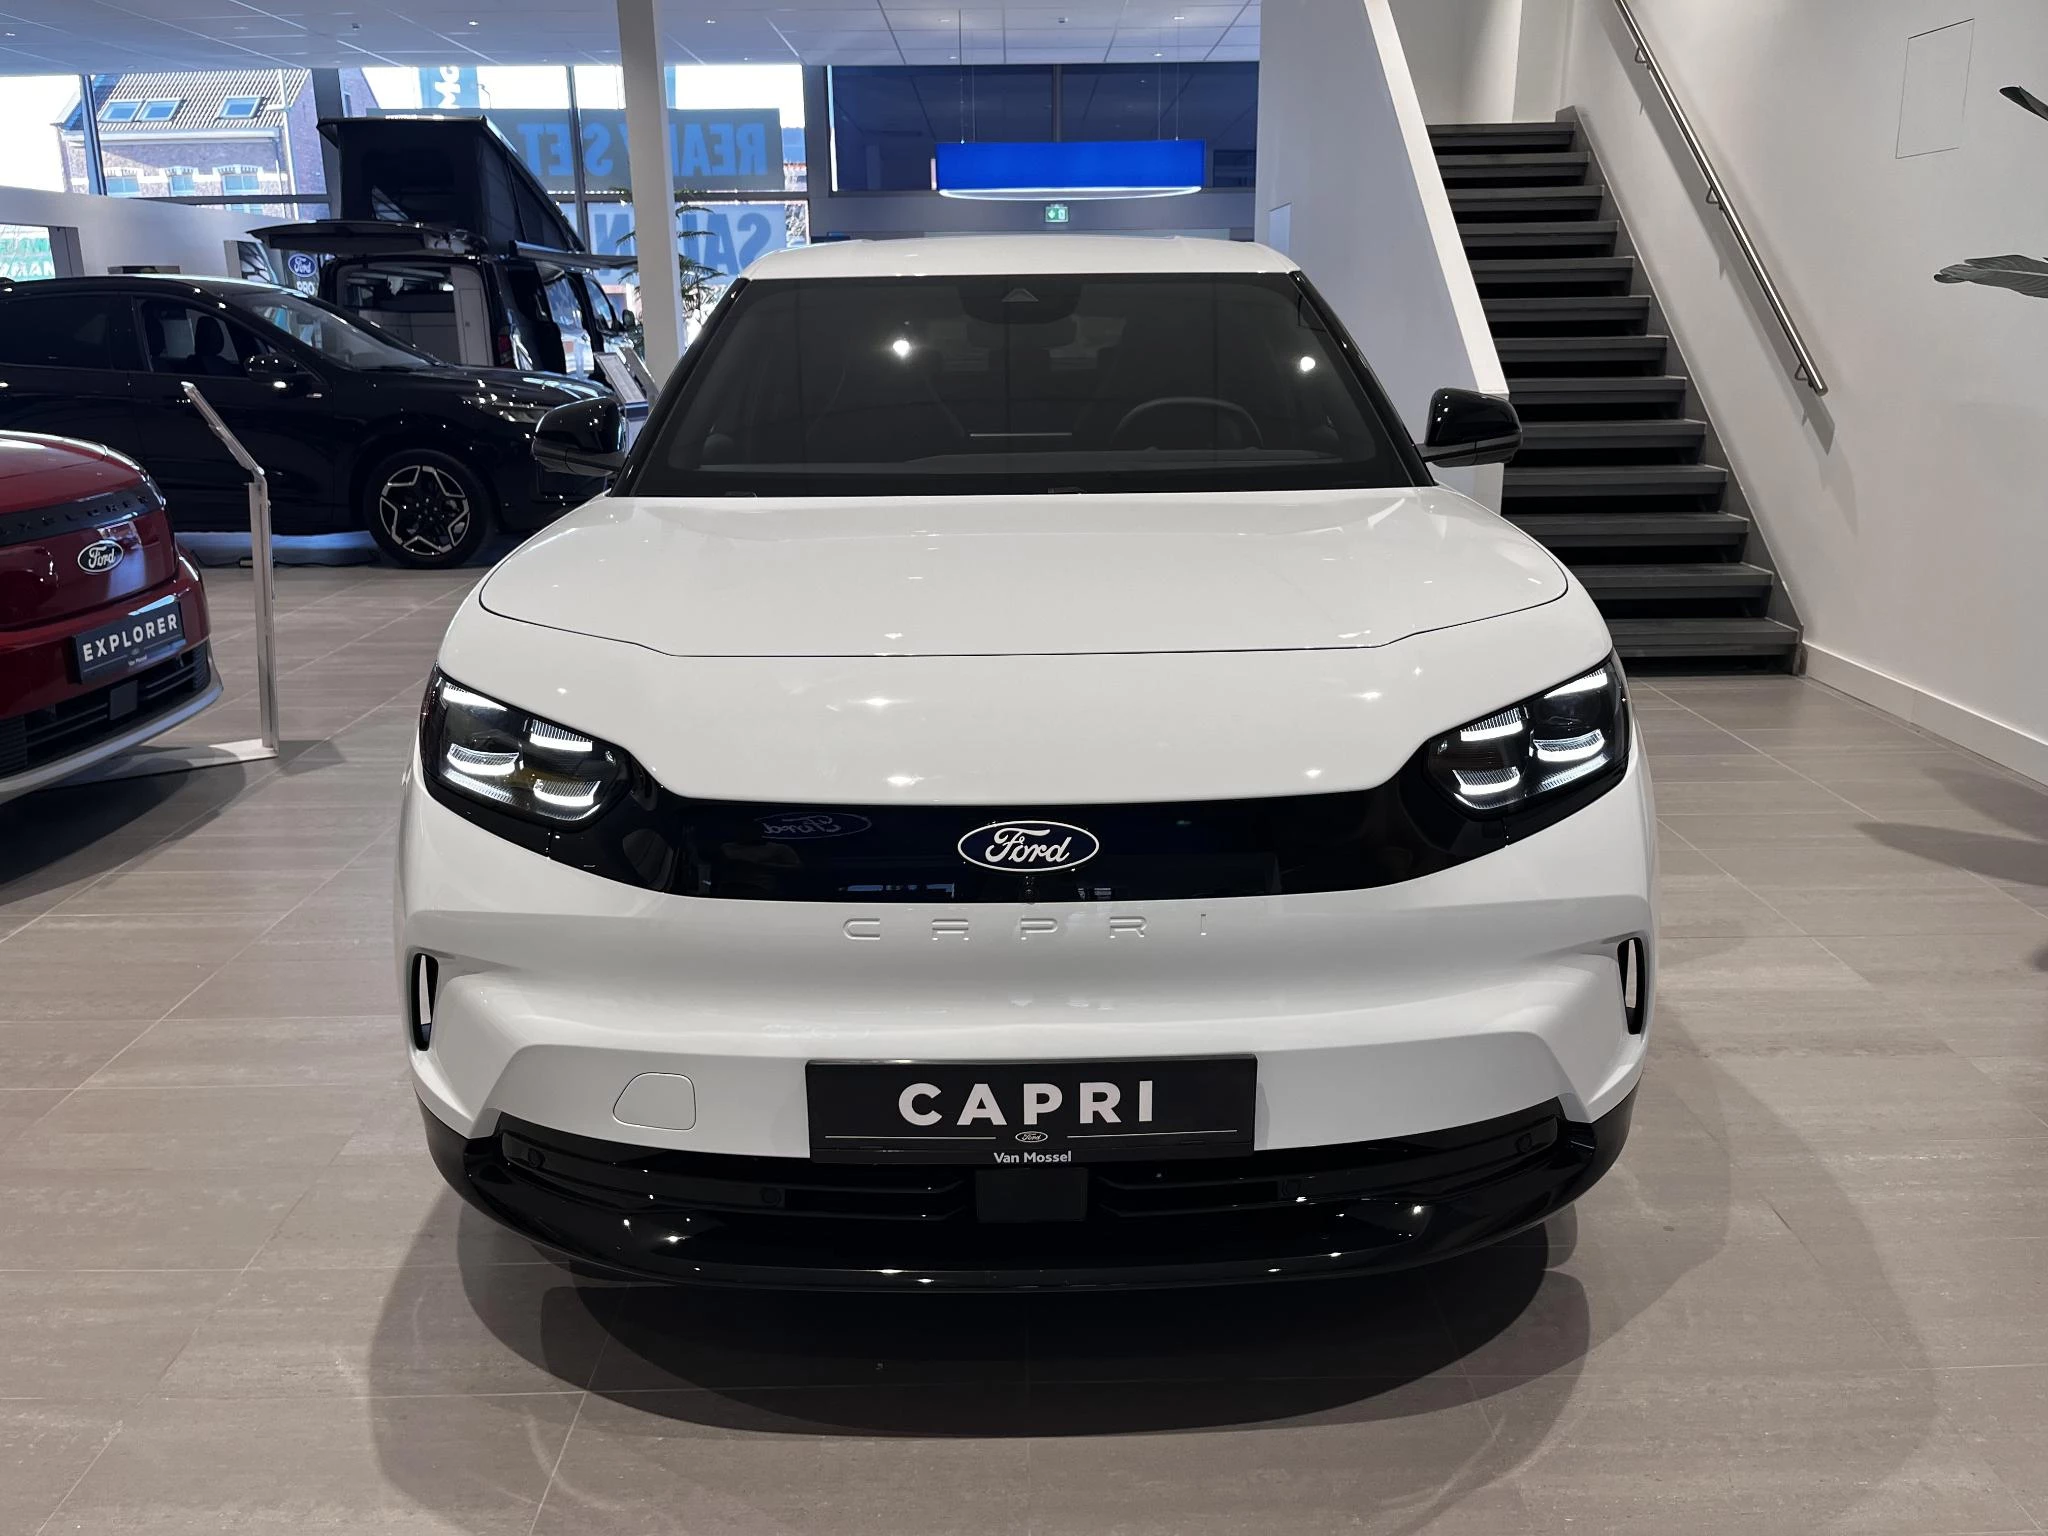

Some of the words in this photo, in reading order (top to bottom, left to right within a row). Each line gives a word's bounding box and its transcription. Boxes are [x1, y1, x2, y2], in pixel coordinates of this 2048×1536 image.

[88, 545, 116, 569] Ford
[82, 613, 178, 662] EXPLORER
[985, 827, 1072, 862] Ford
[843, 914, 1207, 941] CAPRI
[898, 1080, 1153, 1126] CAPRI
[993, 1152, 1020, 1163] Van
[1023, 1150, 1072, 1163] Mossel
